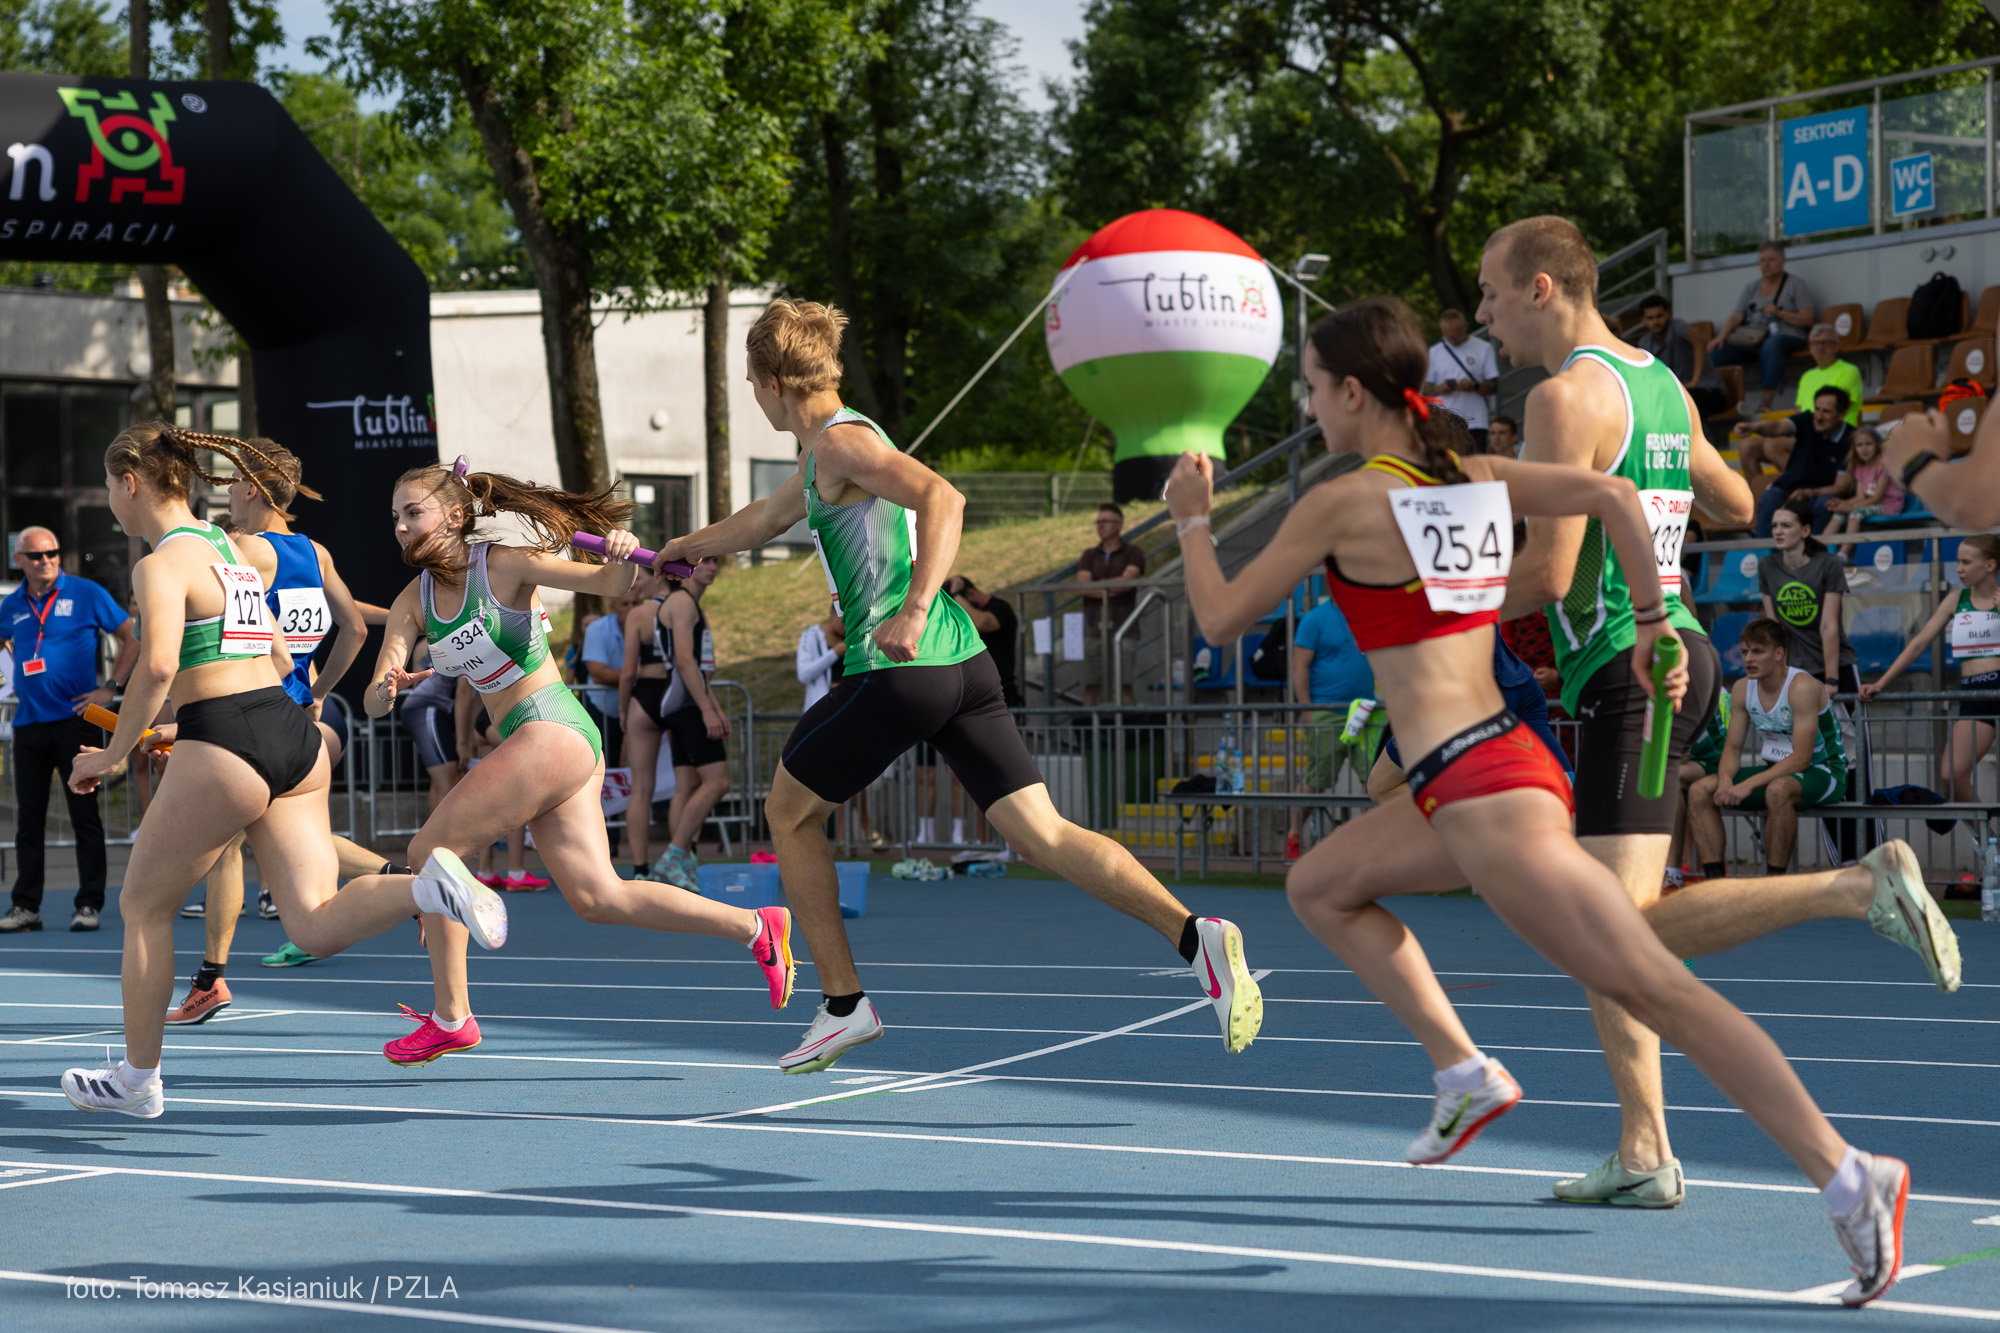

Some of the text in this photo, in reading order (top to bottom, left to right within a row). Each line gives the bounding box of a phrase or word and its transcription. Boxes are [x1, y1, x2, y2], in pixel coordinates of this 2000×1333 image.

[1794, 118, 1856, 144] SEKTORY
[1785, 154, 1864, 210] A-D
[1894, 161, 1930, 191] WC
[1423, 521, 1502, 572] 254
[234, 571, 258, 583] ORLEN
[234, 589, 263, 626] 127
[283, 606, 323, 633] 331
[1786, 606, 1812, 617] AWF
[451, 623, 484, 651] 334
[1971, 671, 1998, 684] PRO
